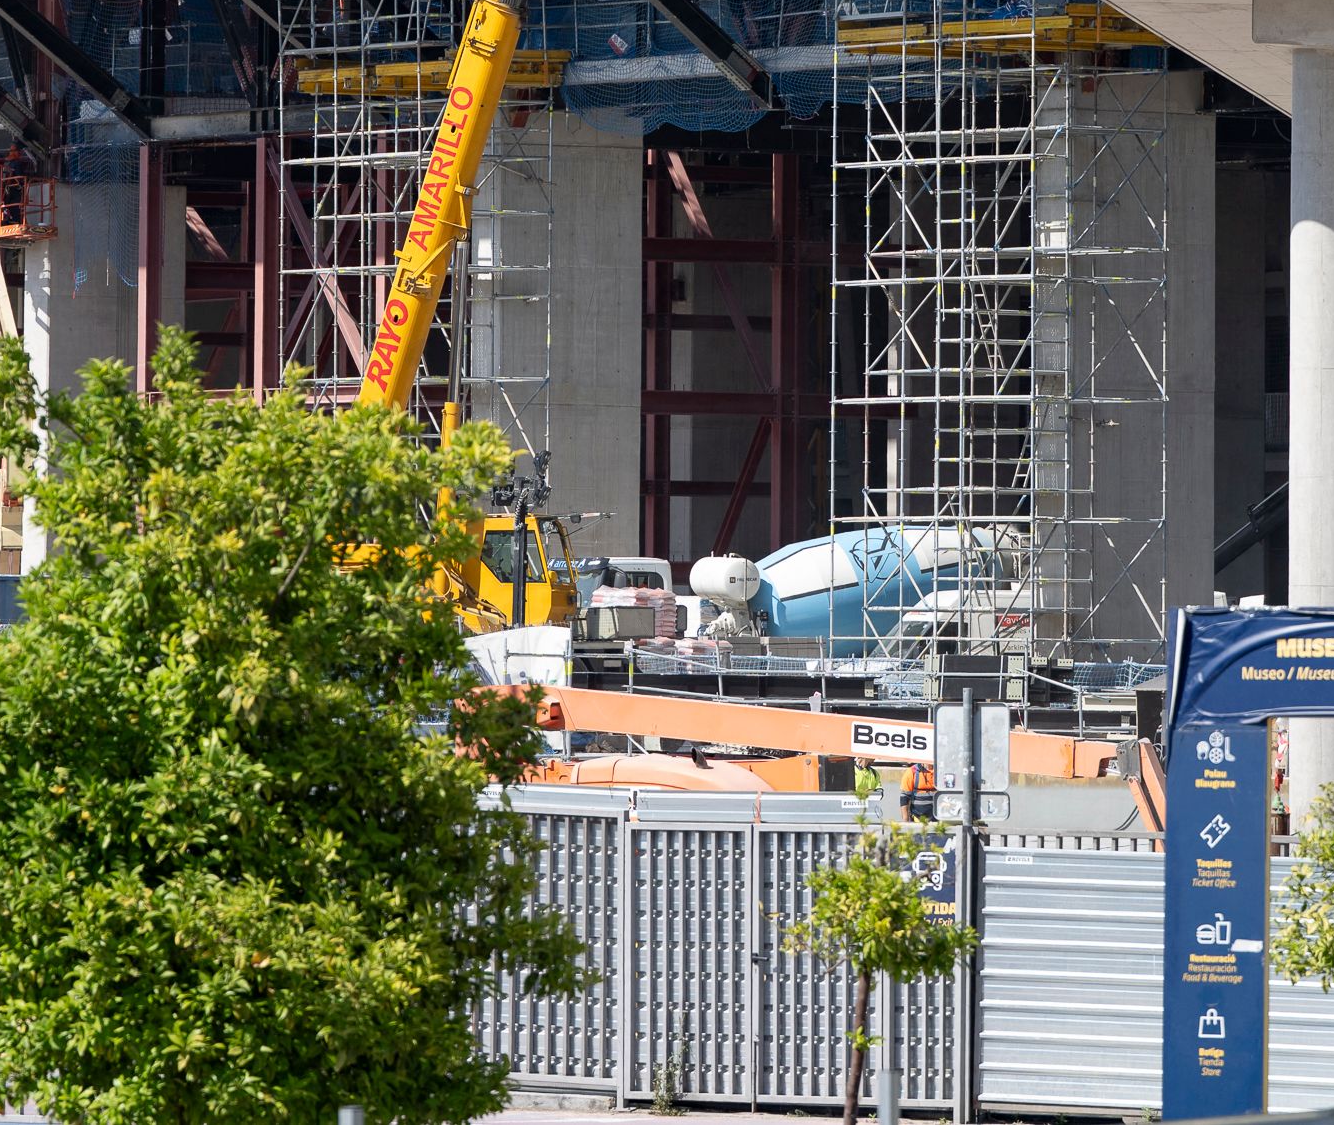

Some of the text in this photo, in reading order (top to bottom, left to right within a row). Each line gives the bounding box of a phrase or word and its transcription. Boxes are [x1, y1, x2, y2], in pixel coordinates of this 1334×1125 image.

[367, 86, 474, 394] RAYO AMARILLO
[1241, 667, 1286, 681] Museo
[853, 724, 927, 751] Boels
[1204, 769, 1227, 779] Palau
[1195, 779, 1236, 789] Blaugrana
[1196, 859, 1232, 869] Taquilles
[1197, 869, 1231, 878] Taquillas
[1192, 878, 1237, 888] Ticket Office
[1182, 973, 1201, 983] Food
[1209, 973, 1243, 984] Beverage
[1199, 1047, 1225, 1059] Botiga
[1199, 1057, 1225, 1067] Tienda
[1201, 1067, 1222, 1076] Store
